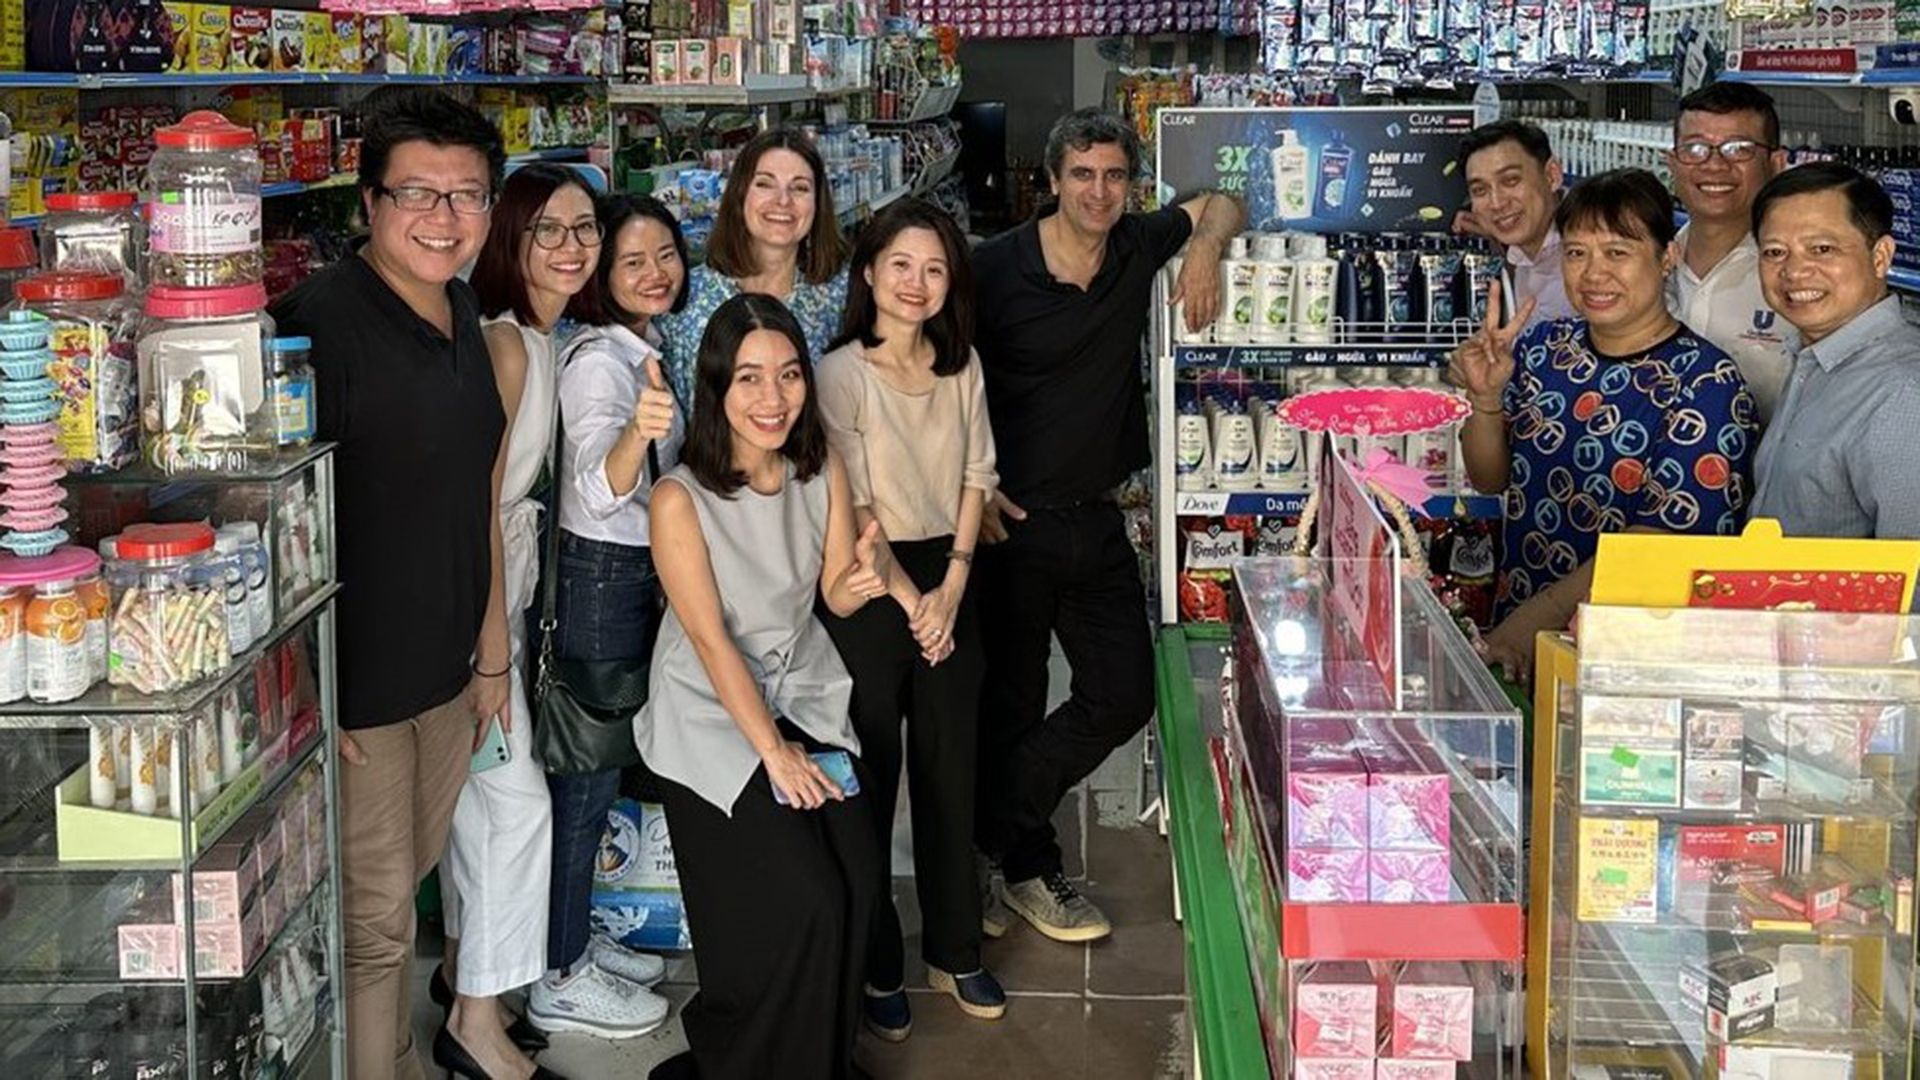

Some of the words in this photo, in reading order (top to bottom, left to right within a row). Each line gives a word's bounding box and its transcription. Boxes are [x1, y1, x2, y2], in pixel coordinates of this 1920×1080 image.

[1162, 113, 1196, 125] CLEAR
[1409, 113, 1445, 125] CLEAR
[1214, 145, 1251, 172] 3X
[1402, 152, 1426, 164] BAY
[1185, 351, 1217, 362] CLEAR
[1240, 350, 1260, 363] 3X
[1183, 497, 1219, 510] Dove
[1191, 540, 1239, 559] Comfort
